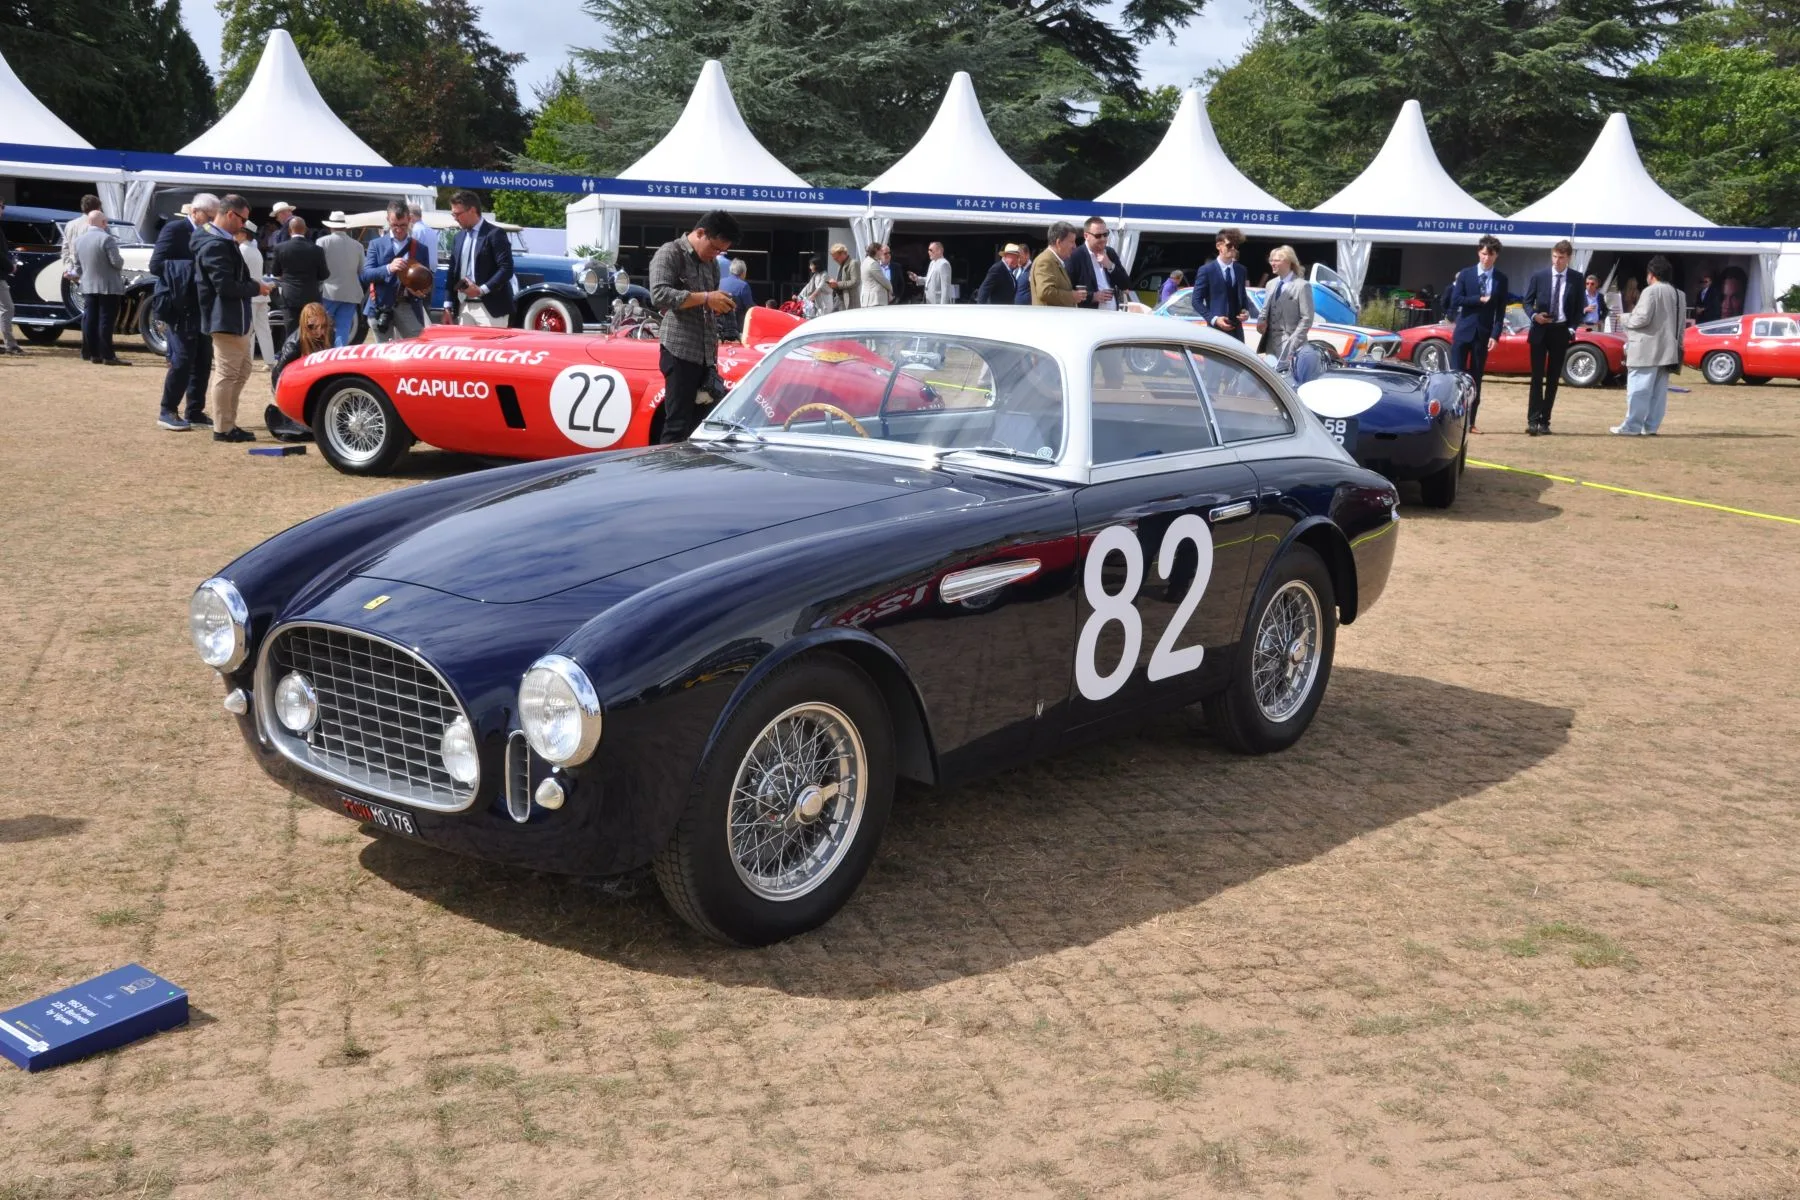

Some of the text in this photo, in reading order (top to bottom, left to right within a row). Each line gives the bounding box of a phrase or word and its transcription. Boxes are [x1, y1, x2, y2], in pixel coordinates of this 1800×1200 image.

[203, 161, 364, 178] THORNTON HUNDRED
[482, 176, 555, 188] WASHROOMS
[647, 184, 825, 200] SYSTEM STORE SOLUTIONS
[956, 199, 1041, 211] KRAZY HORSE
[1201, 210, 1280, 222] KRAZY HORSE
[1416, 220, 1515, 232] ANTOINE DUFILHO
[1654, 229, 1705, 238] GATINEAU
[427, 345, 550, 365] AMERICAS
[396, 377, 490, 400] ACAPULCO
[568, 371, 616, 433] 22
[755, 394, 775, 418] EXICO
[1324, 418, 1347, 434] 58
[1075, 514, 1214, 701] 82
[370, 806, 388, 826] MO
[390, 812, 413, 834] 178
